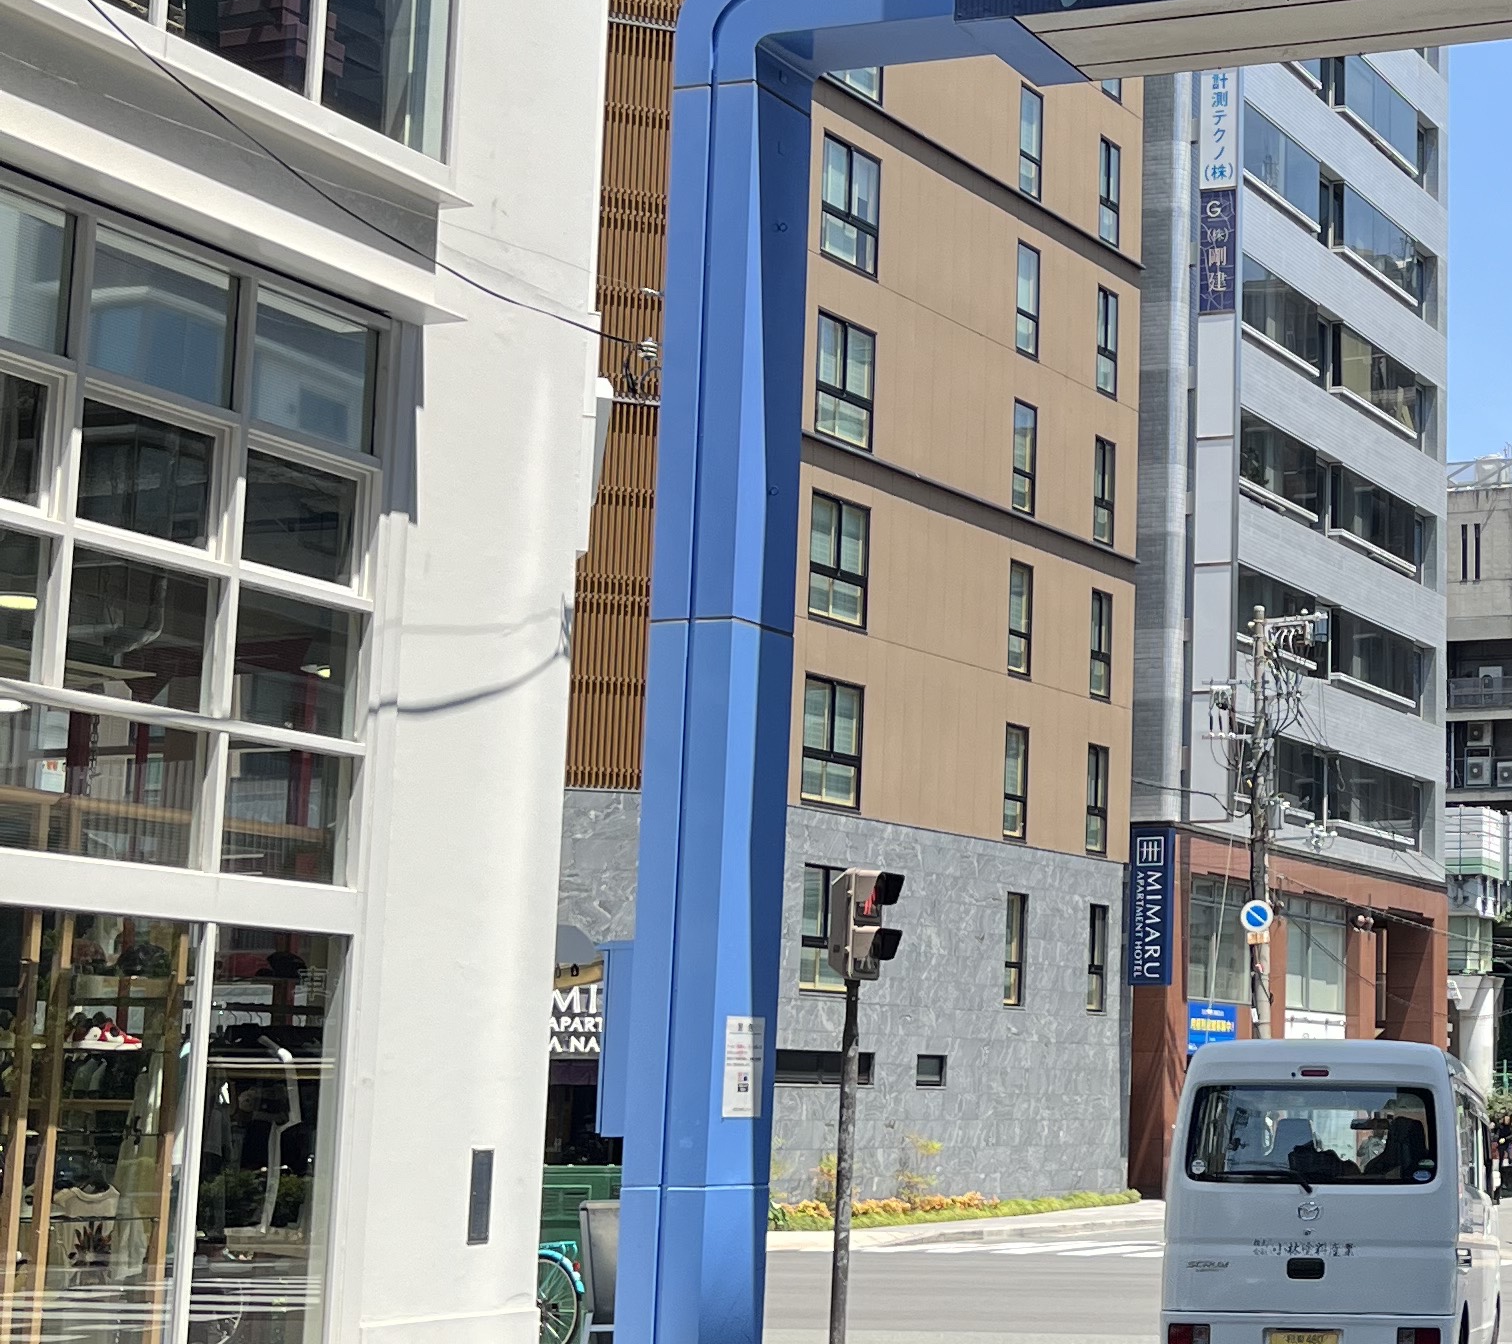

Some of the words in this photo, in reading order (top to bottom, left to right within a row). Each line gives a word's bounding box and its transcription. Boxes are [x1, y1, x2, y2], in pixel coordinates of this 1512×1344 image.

[1206, 200, 1222, 218] G
[1134, 871, 1145, 938] APARTMENT
[1143, 870, 1163, 979] MIMARU
[1132, 941, 1143, 978] HOTEL
